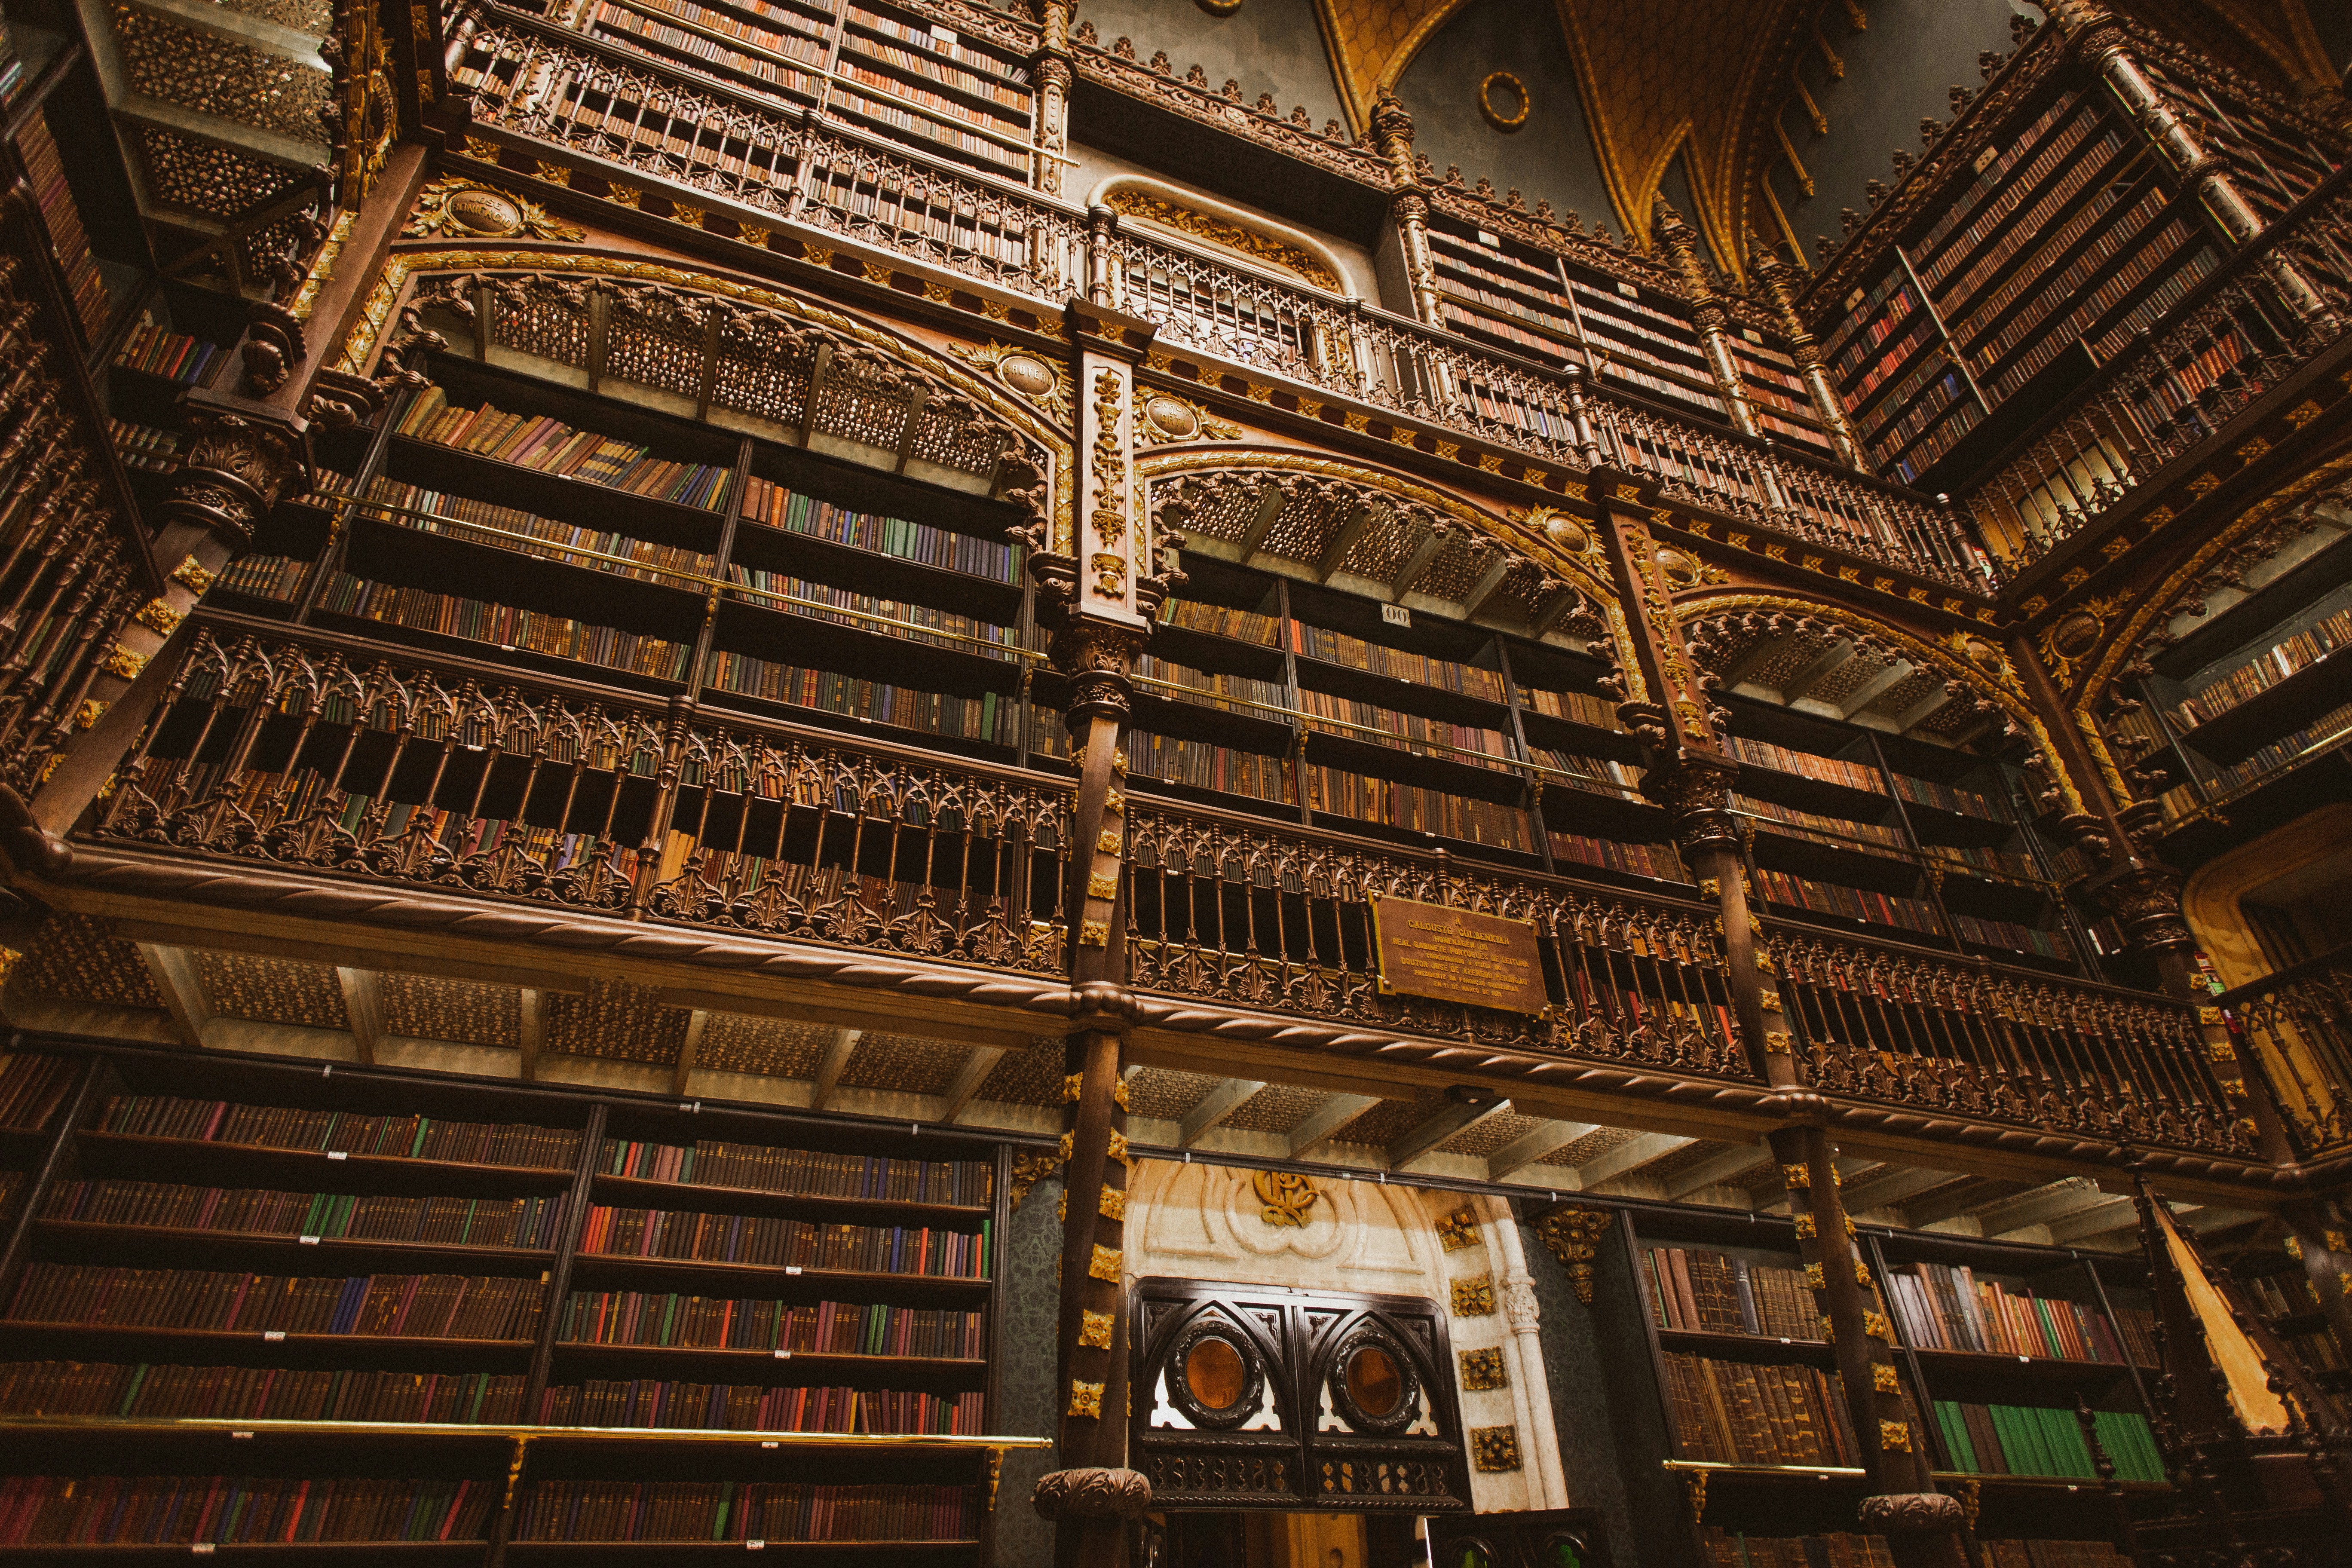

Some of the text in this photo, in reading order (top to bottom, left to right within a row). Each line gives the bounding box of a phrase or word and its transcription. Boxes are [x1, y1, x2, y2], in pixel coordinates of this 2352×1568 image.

[452, 203, 513, 228] BONIFACIO
[1004, 364, 1052, 386] BROTERO
[1408, 919, 1510, 946] CALOUSTE GULBENKIAN
[1434, 936, 1475, 949] HOMENAGEM
[1393, 938, 1411, 947] REAL
[1414, 941, 1447, 953] GABINETE
[1501, 956, 1529, 968] LEITURA
[1426, 953, 1465, 965] COMEMORANDO
[1400, 957, 1429, 968] DOUTOR
[1462, 968, 1493, 980] AZEREDO
[1414, 969, 1446, 980] PRESIDENTE
